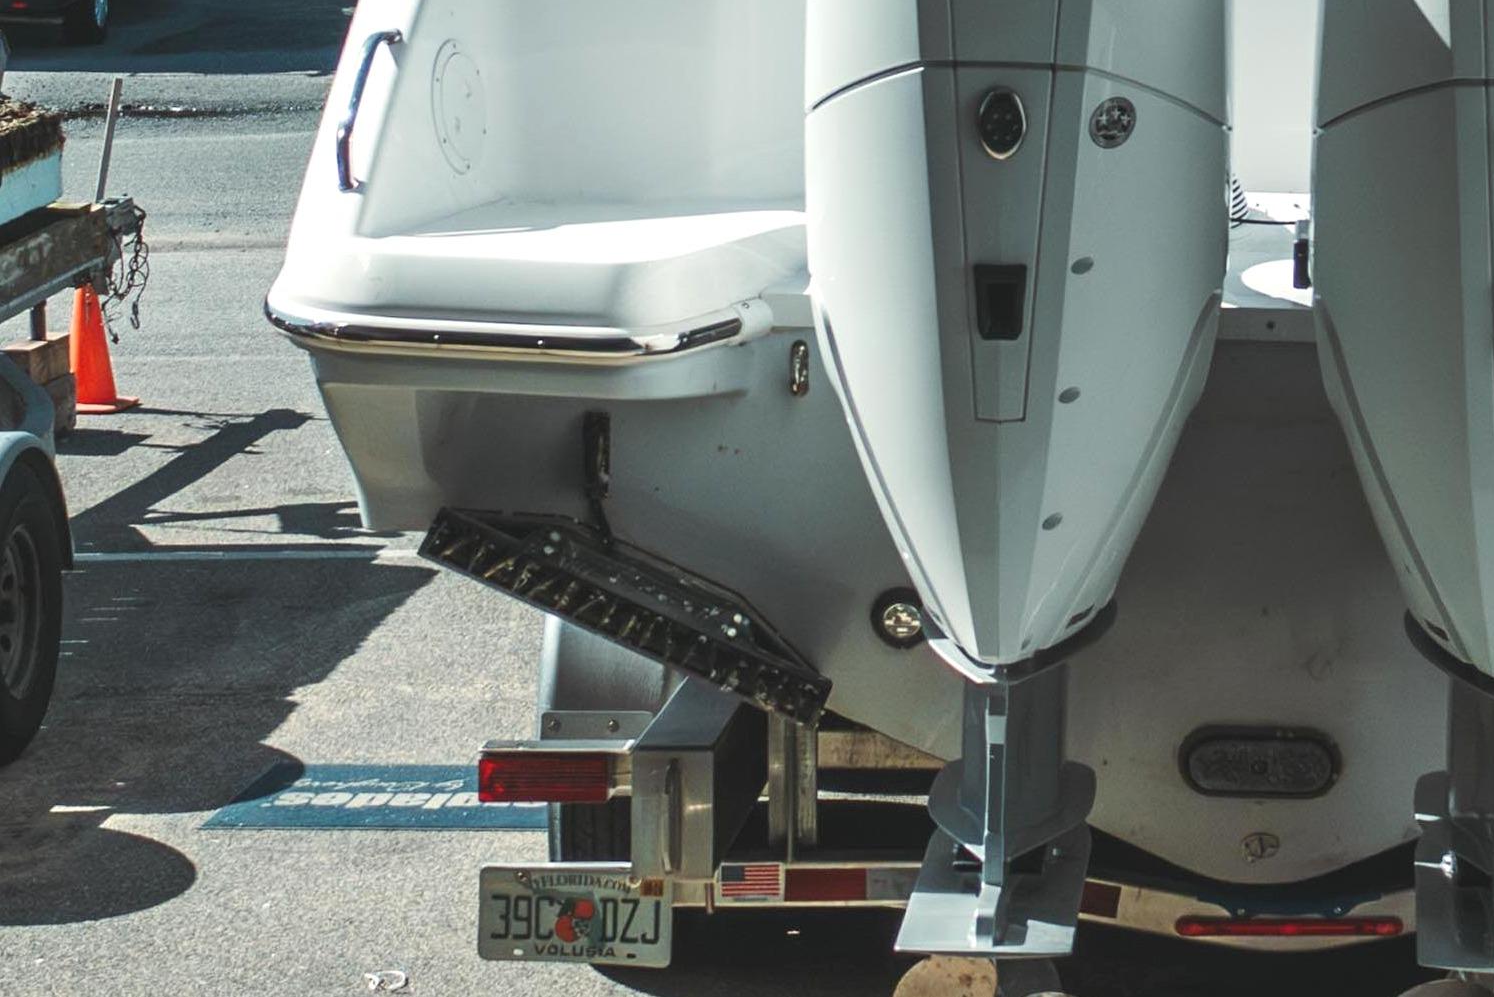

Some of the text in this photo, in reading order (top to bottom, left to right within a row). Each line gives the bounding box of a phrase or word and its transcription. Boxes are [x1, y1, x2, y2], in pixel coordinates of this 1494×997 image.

[490, 894, 661, 945] 39C DZJ
[534, 944, 617, 958] VOLUSIA
